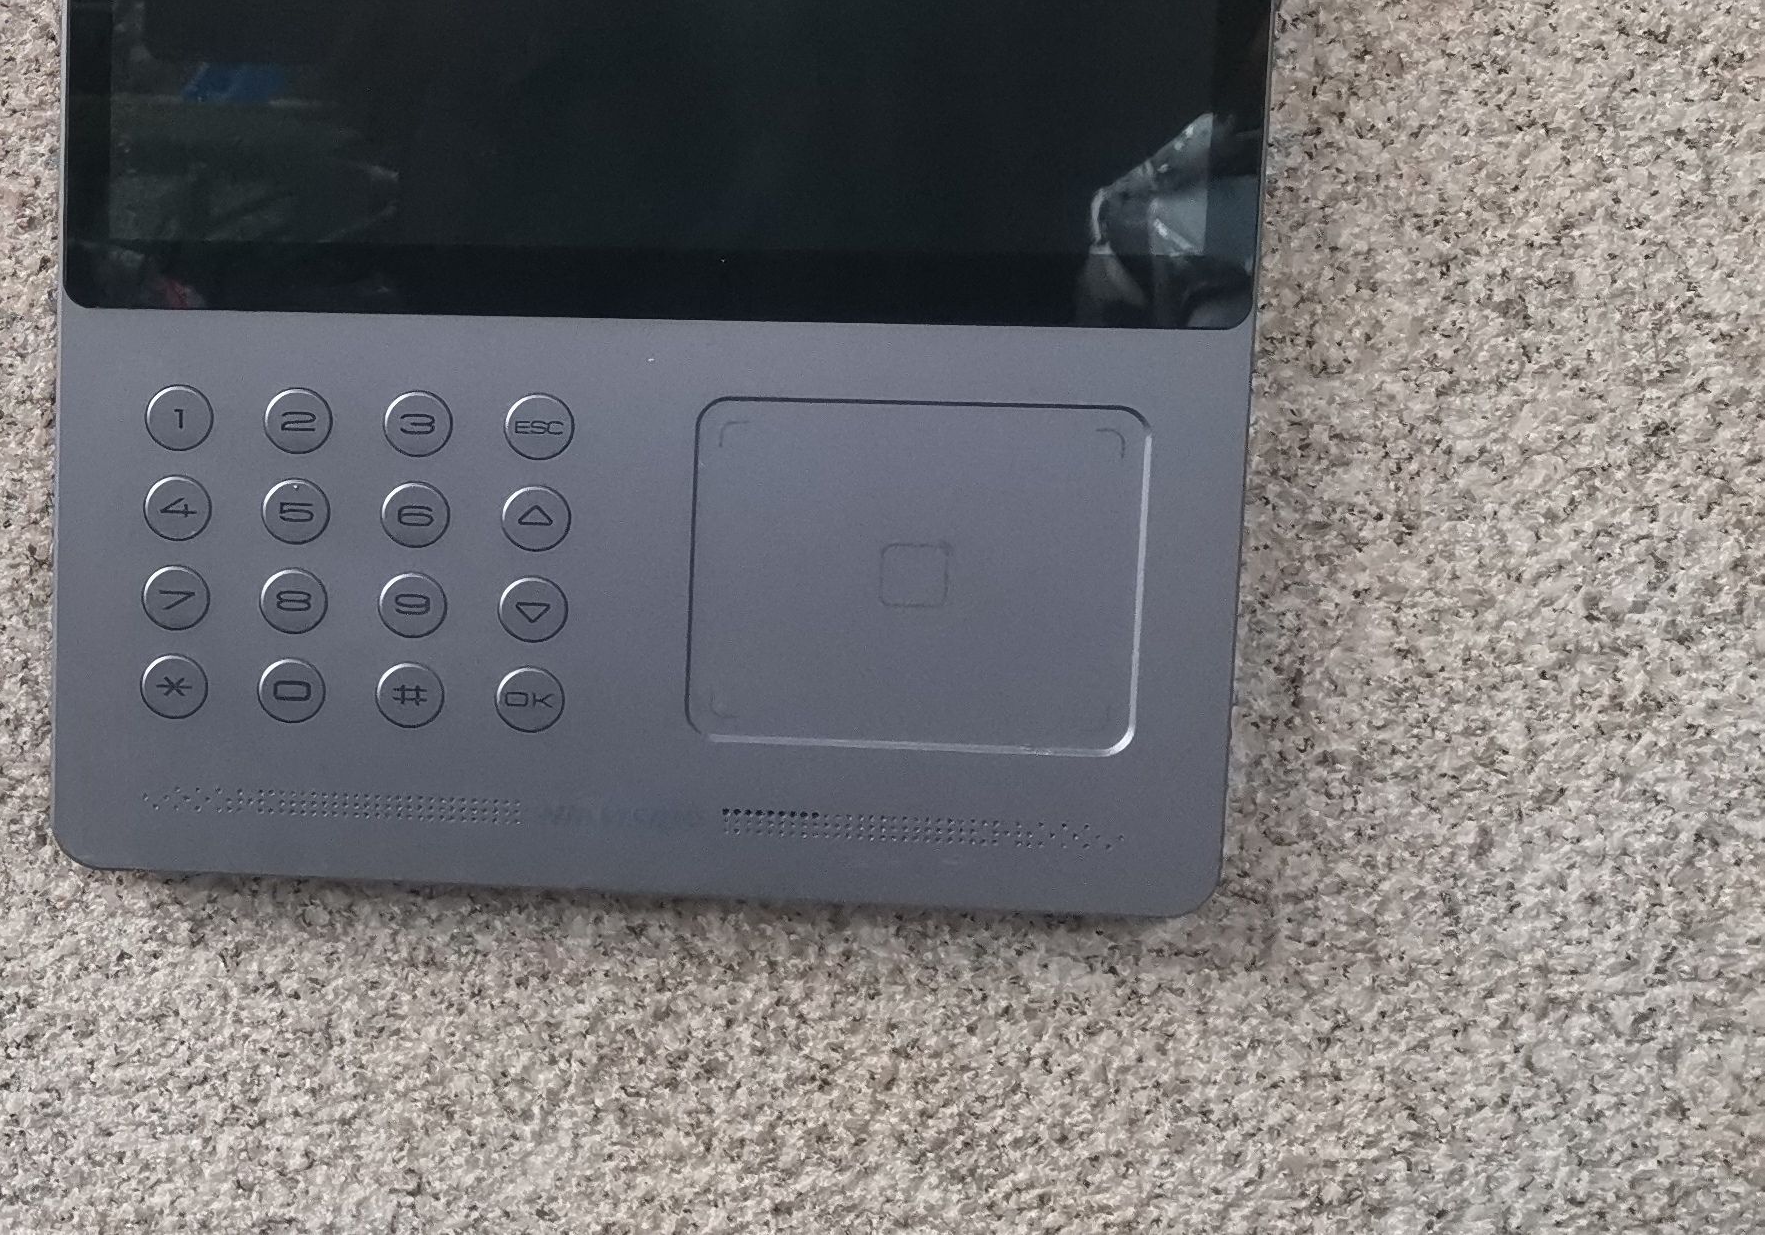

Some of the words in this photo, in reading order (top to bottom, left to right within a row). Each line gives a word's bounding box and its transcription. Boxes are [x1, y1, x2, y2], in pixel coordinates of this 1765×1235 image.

[174, 408, 184, 429] 1
[281, 411, 316, 432] 2
[399, 413, 435, 435] 3
[514, 420, 564, 435] ESC
[159, 497, 197, 518] 4
[279, 502, 315, 523] 5
[397, 505, 434, 528] 6
[159, 589, 196, 610] 7
[276, 589, 312, 612] 8
[394, 593, 430, 616] 9
